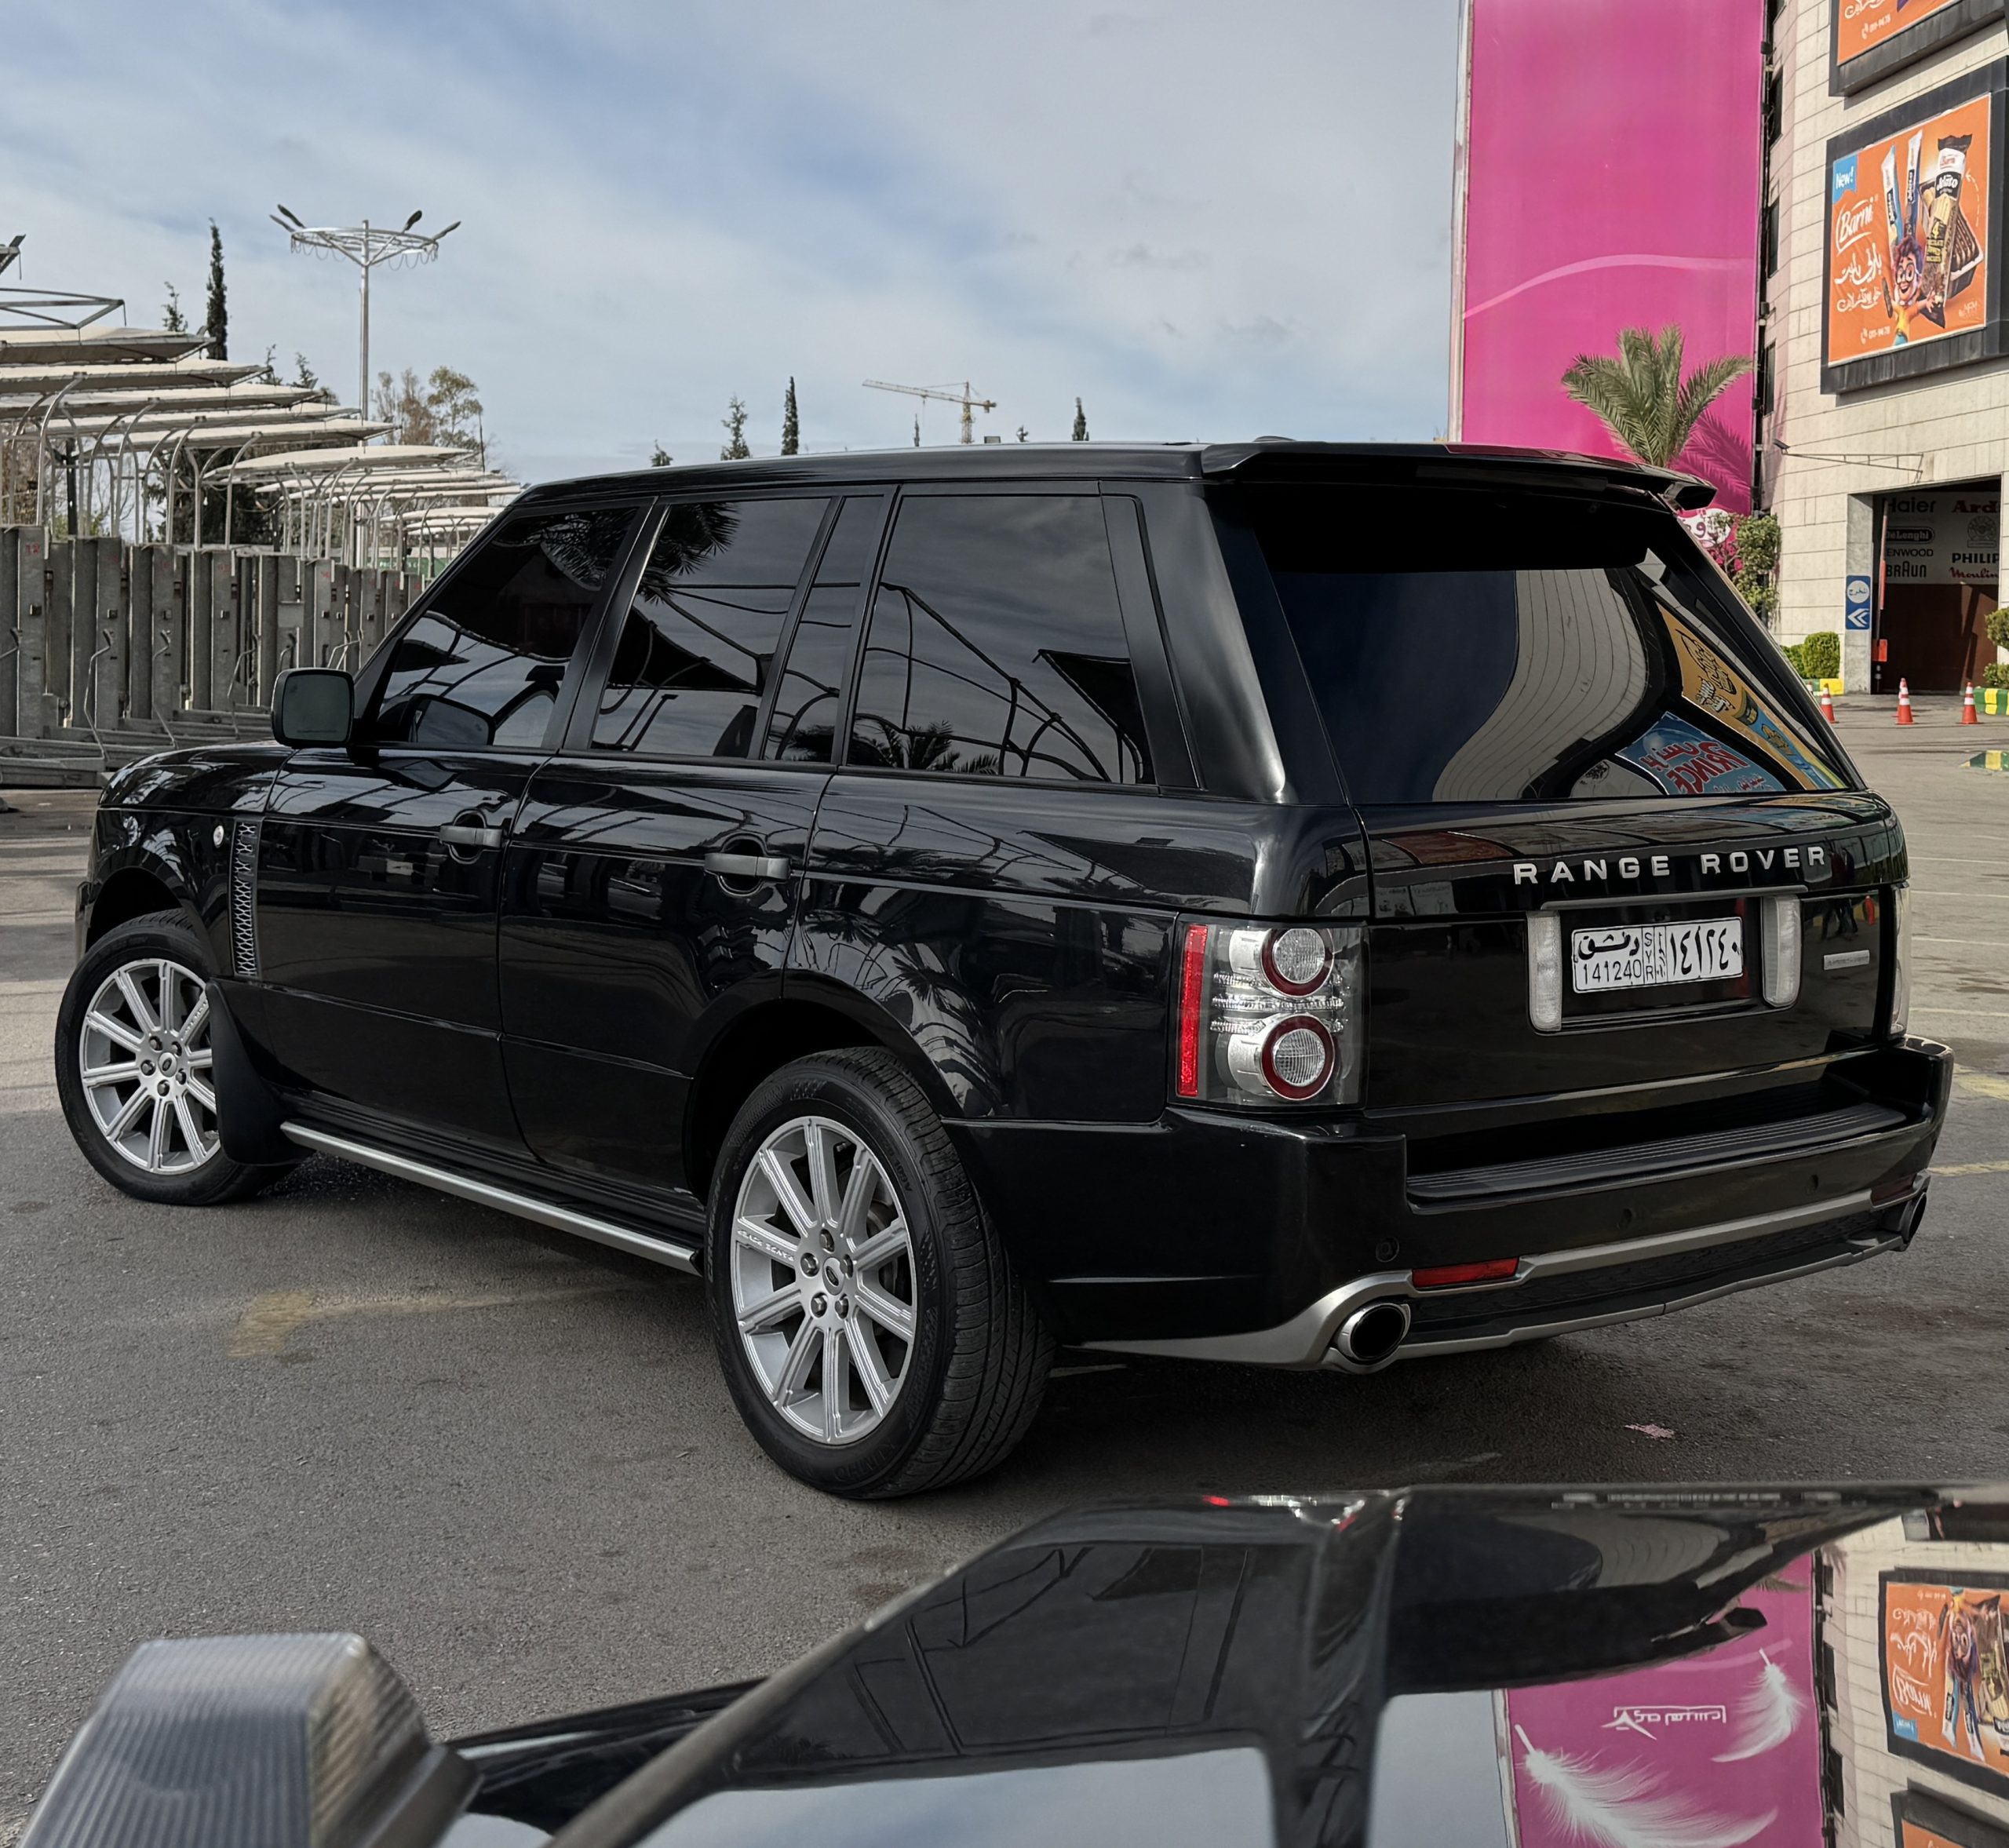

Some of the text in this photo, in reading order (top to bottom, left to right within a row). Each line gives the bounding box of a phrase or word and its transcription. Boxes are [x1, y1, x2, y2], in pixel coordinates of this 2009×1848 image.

[1836, 166, 1854, 189] New!
[1838, 196, 1873, 243] Barni
[1952, 500, 1998, 513] Ard
[1886, 549, 1934, 557] ENWOOD
[1952, 552, 1999, 563] PHILIP
[1886, 560, 1927, 578] BRAUN
[1949, 567, 1998, 578] Moulin
[1513, 846, 1825, 885] RANGE ROVER
[1577, 931, 1640, 960] دمشق
[1645, 931, 1654, 981] SYR
[1670, 925, 1738, 976] ١٤١٢٤٠
[1583, 959, 1643, 985] 141240
